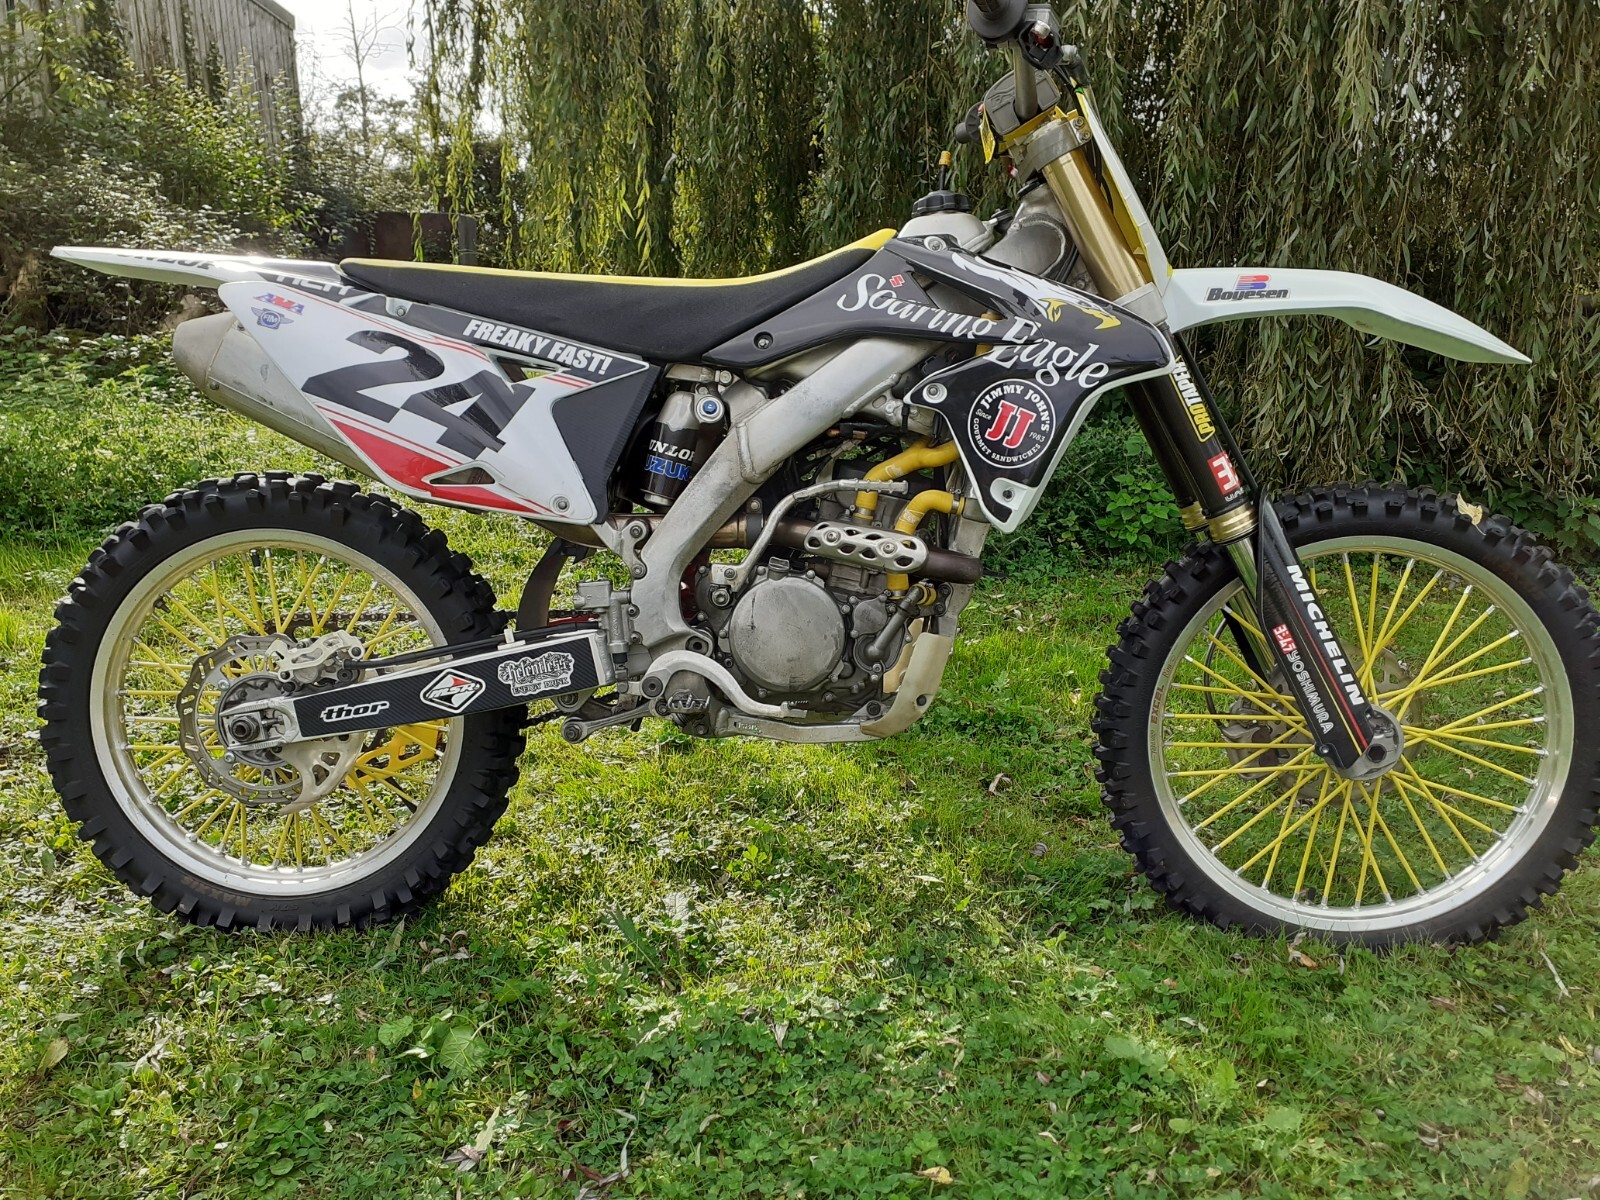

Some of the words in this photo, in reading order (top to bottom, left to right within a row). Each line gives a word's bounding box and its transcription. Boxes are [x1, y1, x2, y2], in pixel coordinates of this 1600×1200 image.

[252, 292, 305, 315] AMA
[1206, 287, 1289, 302] Boyesen
[263, 313, 278, 323] FIM
[837, 273, 997, 339] Soaring
[983, 316, 1110, 389] Eagle
[463, 319, 551, 355] FREAKY
[547, 341, 613, 375] FAST!
[301, 330, 536, 460] 24
[975, 408, 992, 420] Since
[980, 384, 1025, 410] JIMMY
[1024, 389, 1051, 433] JOHN'S
[985, 399, 1037, 449] JJ
[1029, 431, 1046, 443] 1983
[1190, 403, 1215, 434] PRO
[973, 417, 992, 455] GOURMET
[991, 443, 1041, 463] SANDWICHES
[1286, 564, 1365, 706] MICHELIN
[544, 677, 570, 688] DRINK
[1287, 649, 1334, 735] YOSHIMURA
[321, 701, 389, 722] thor
[1151, 684, 1165, 725] EXCEL
